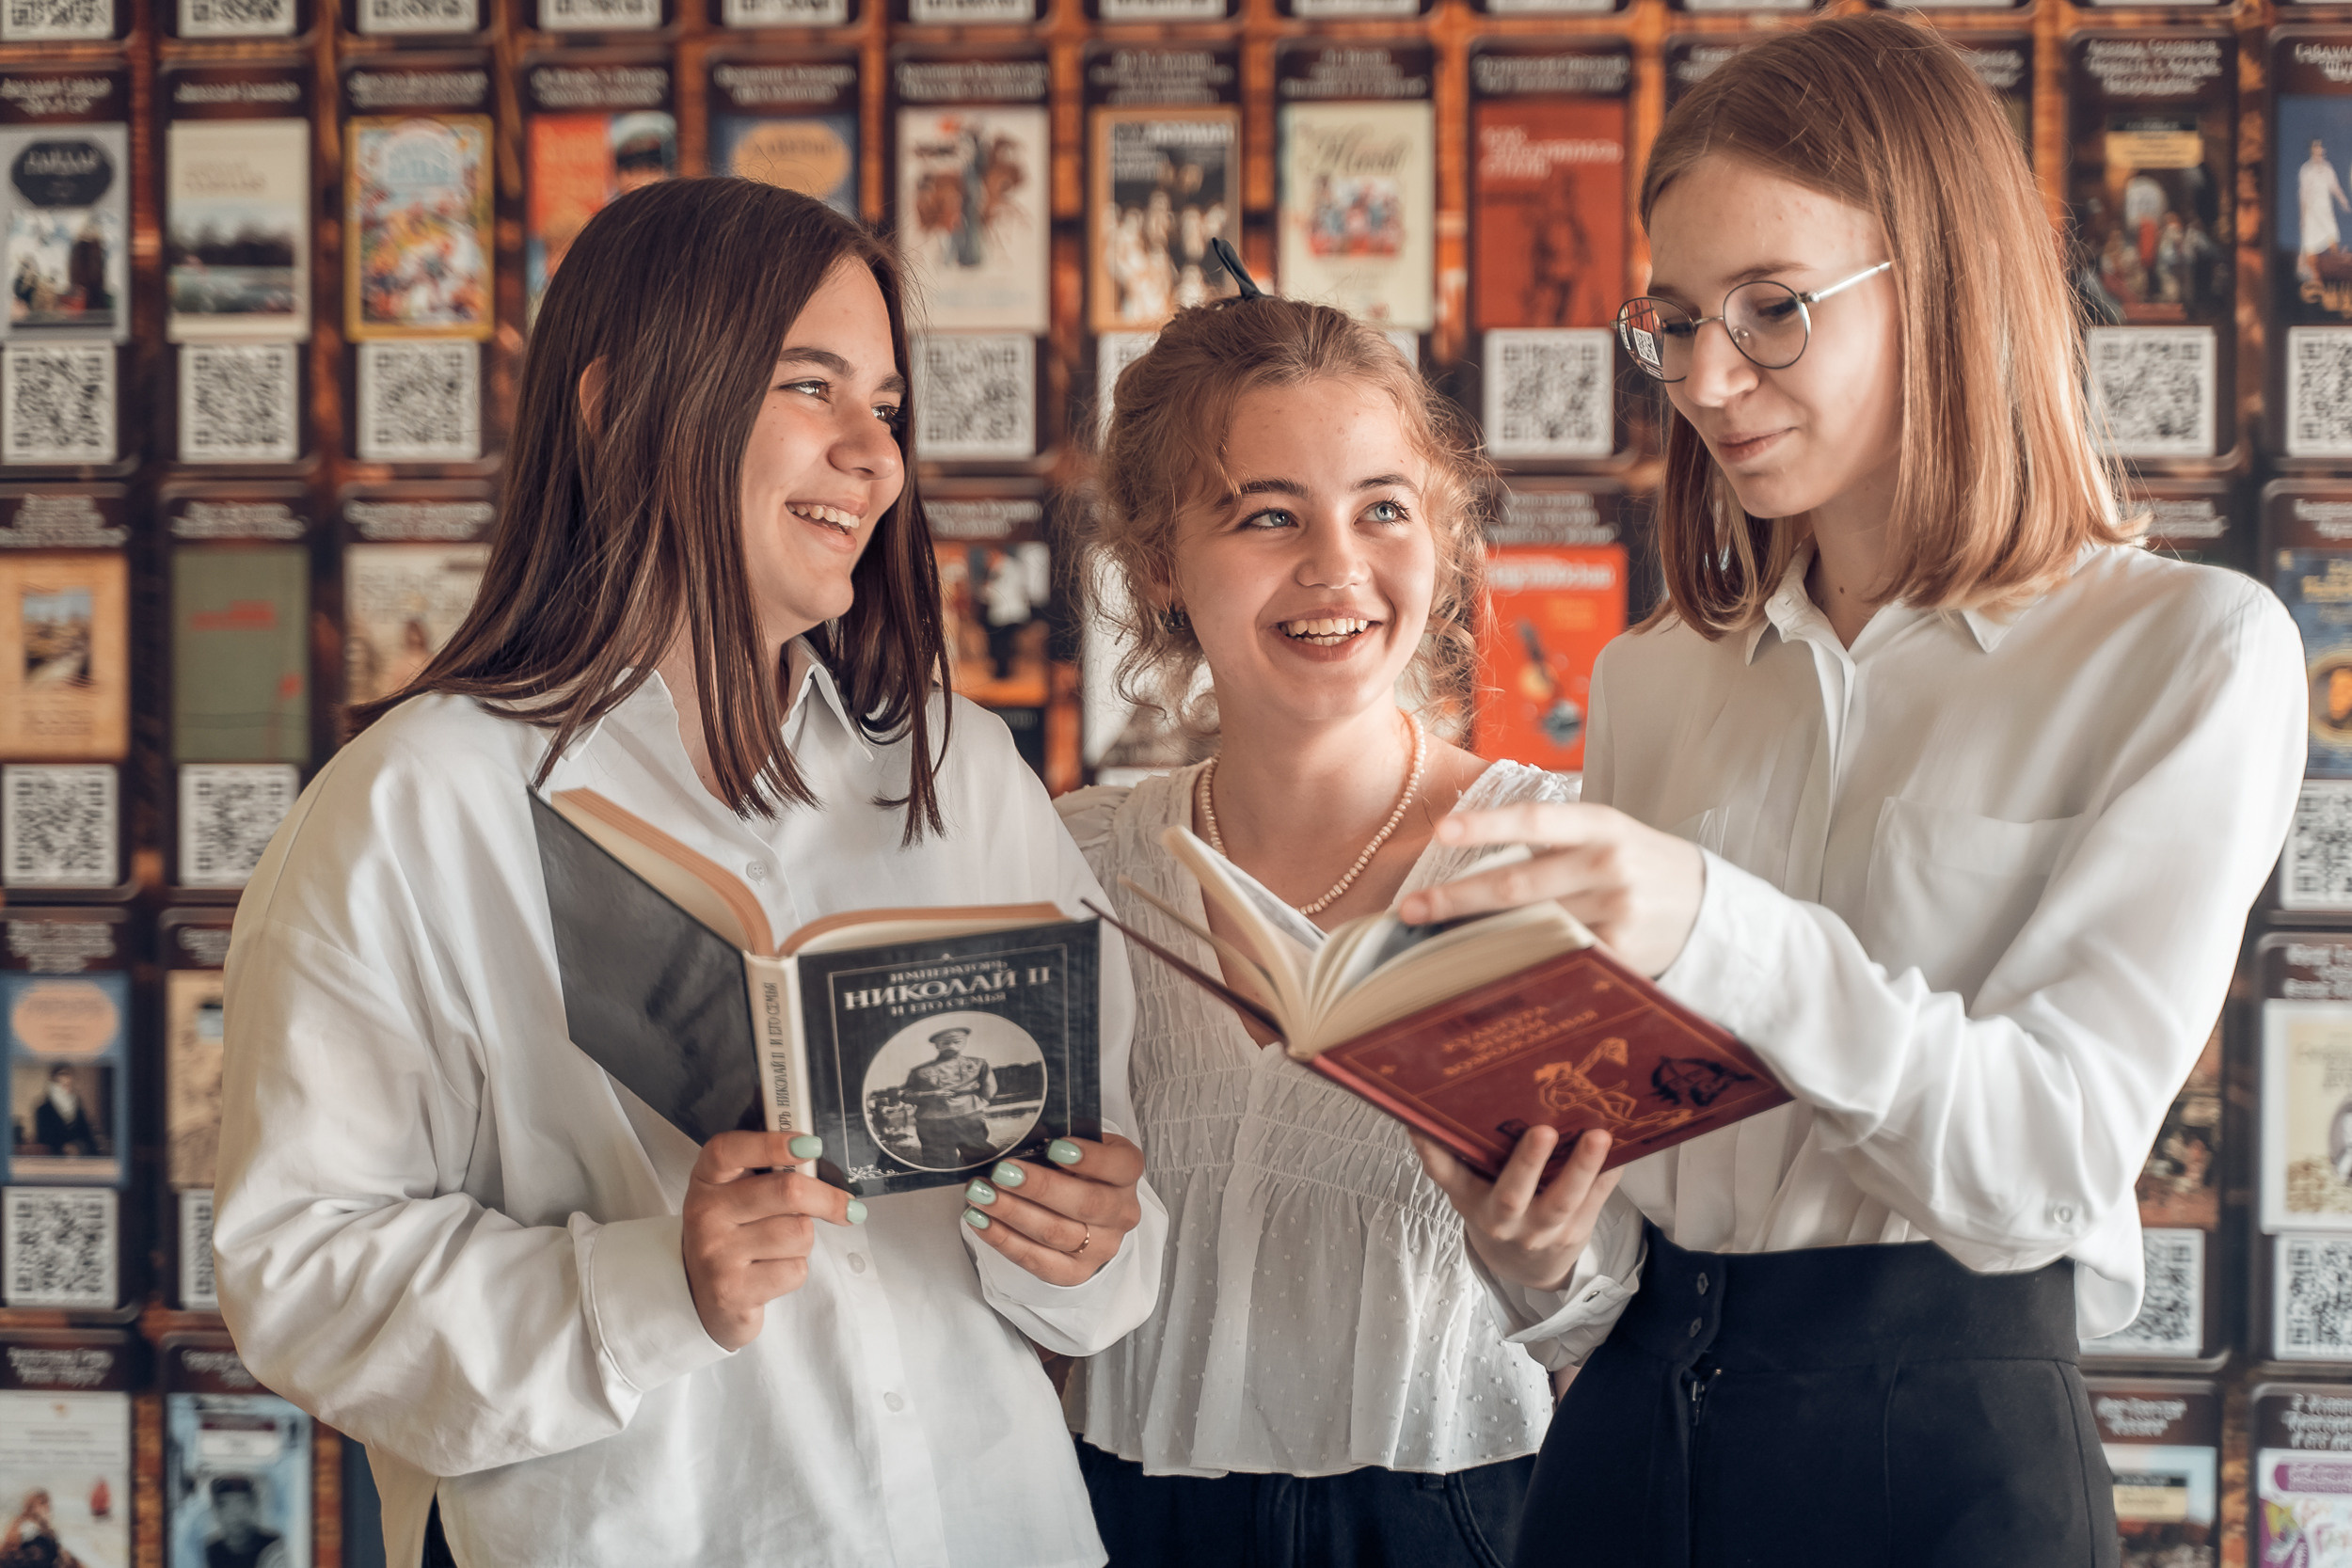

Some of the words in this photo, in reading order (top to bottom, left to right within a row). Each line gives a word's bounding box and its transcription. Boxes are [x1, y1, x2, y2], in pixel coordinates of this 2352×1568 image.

[763, 982, 780, 1016] СЕМЬЯ
[845, 969, 1016, 1010] НИКОЛАЙ
[890, 1005, 905, 1017] И
[910, 1000, 944, 1015] ЕГО
[946, 991, 1007, 1009] СЕМЬЯ
[767, 1017, 783, 1036] ЕГО
[771, 1061, 790, 1107] НИКОЛАЙ
